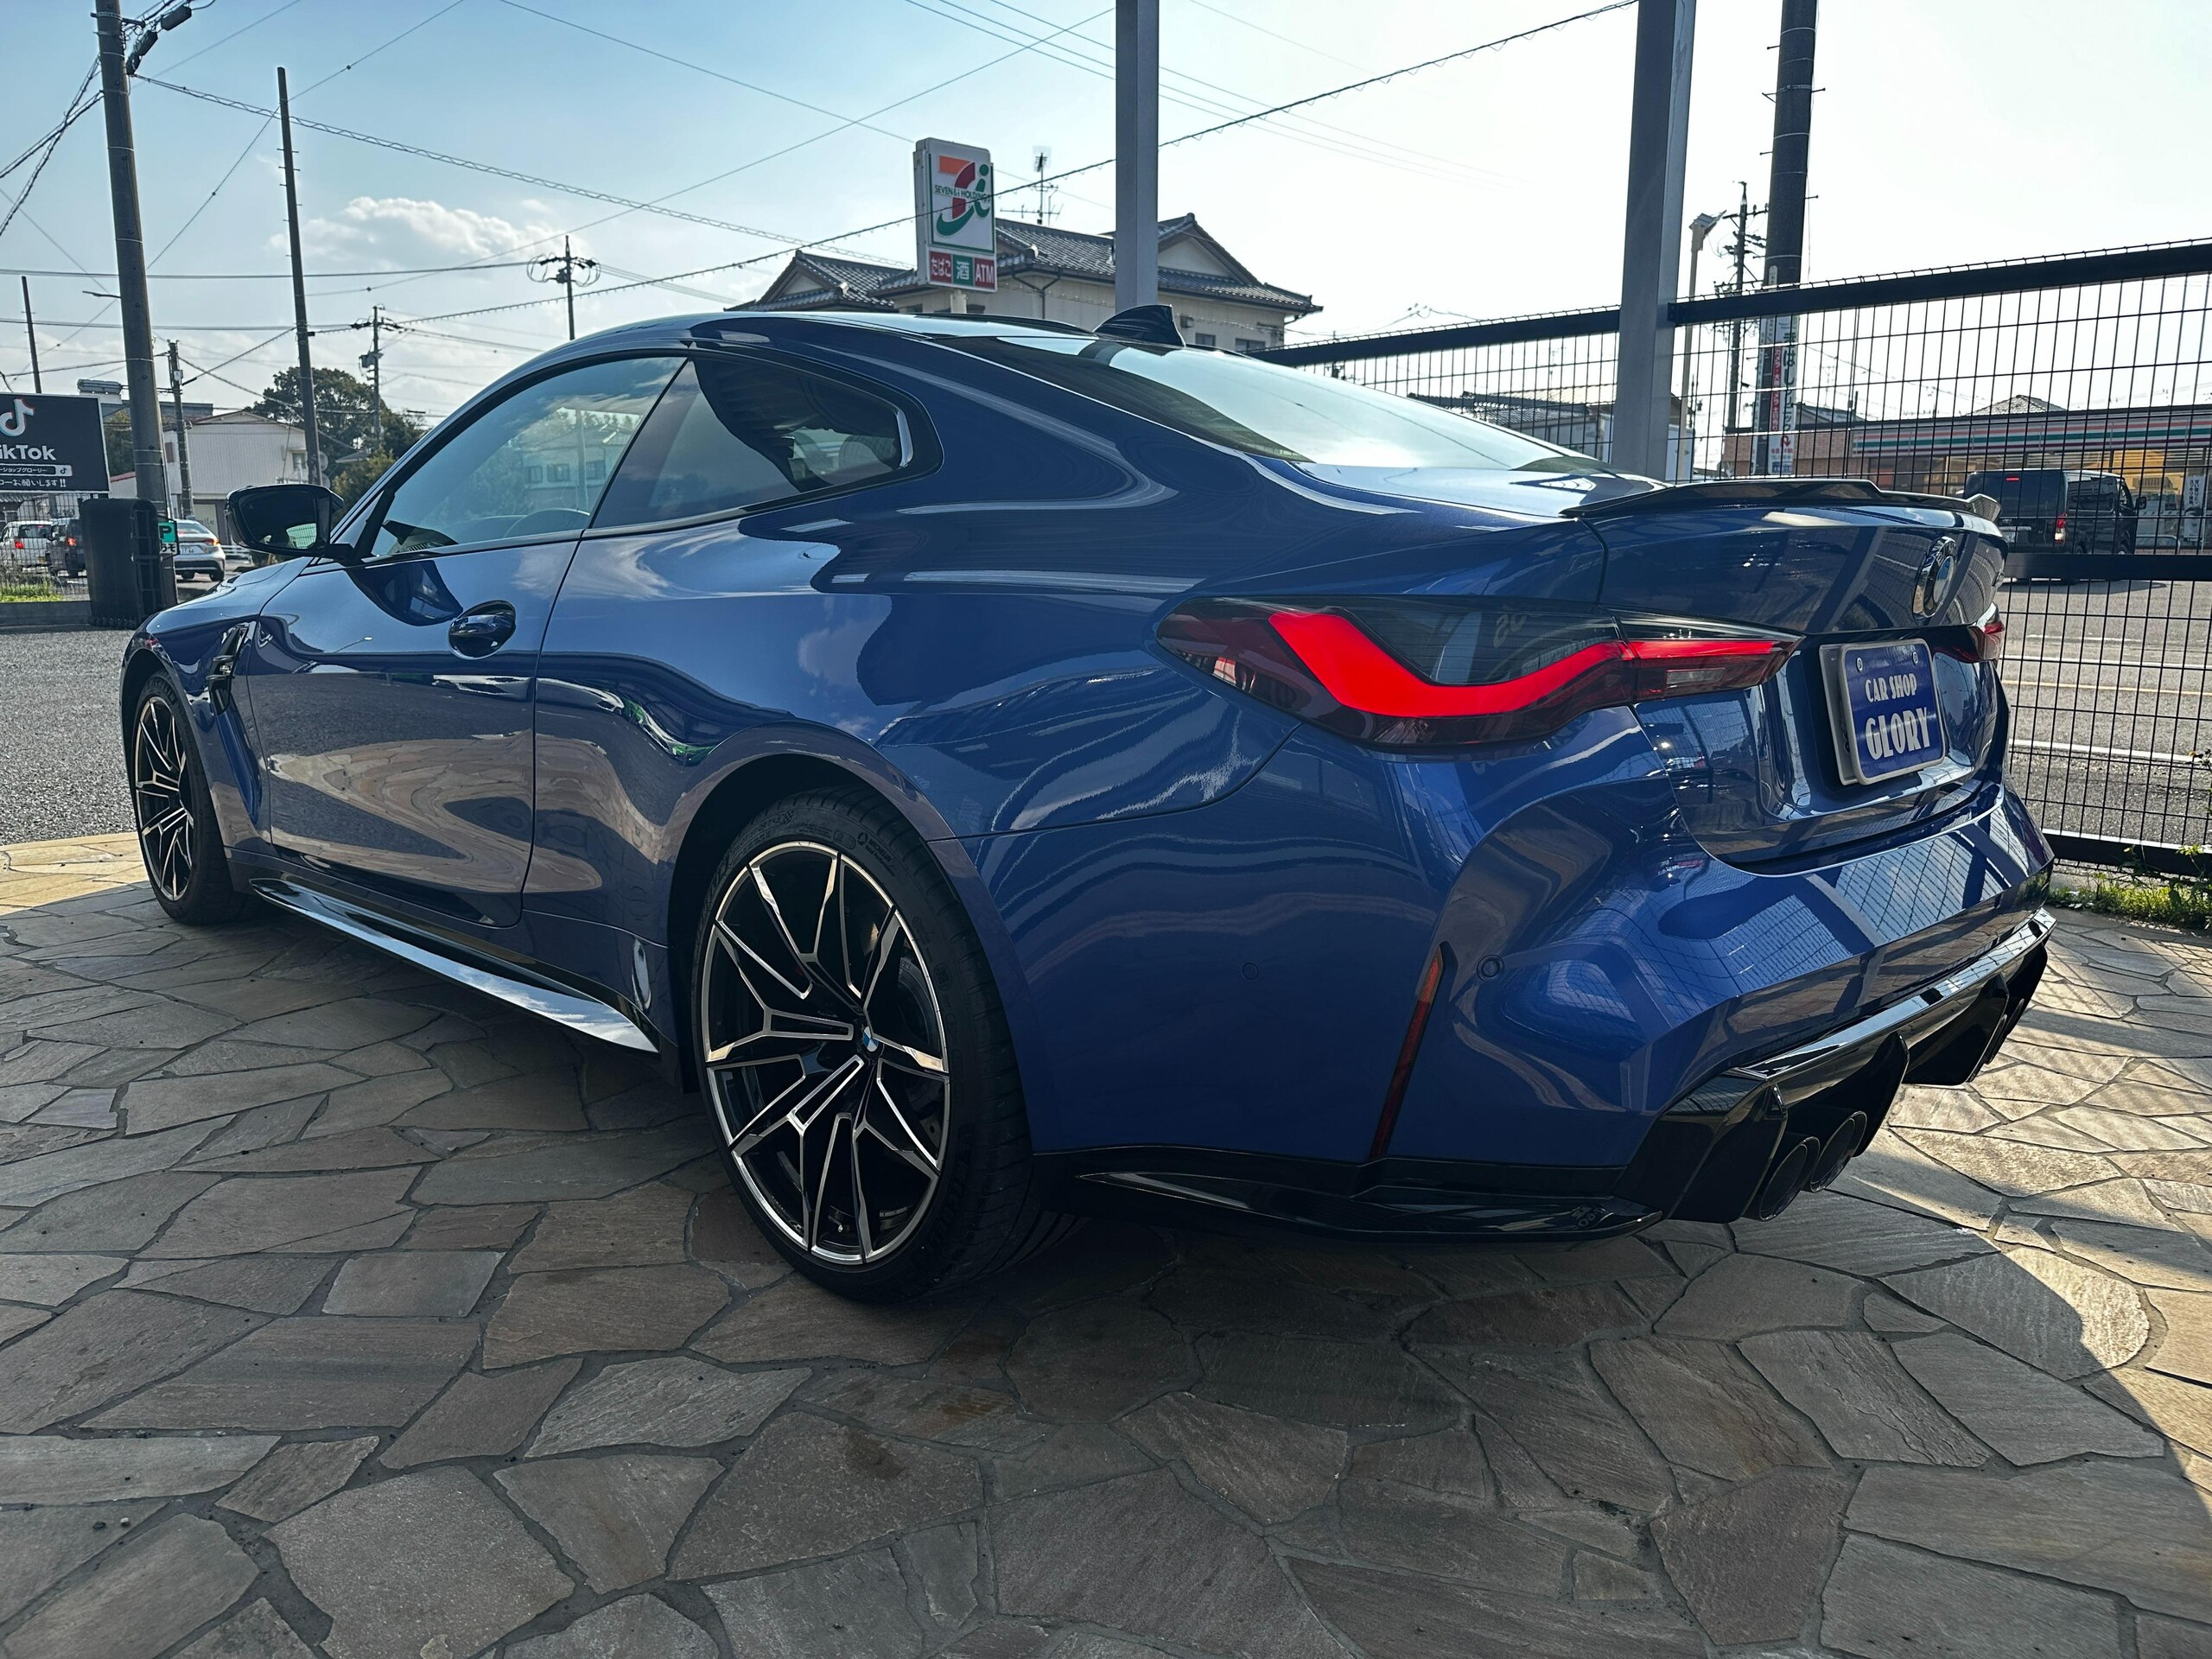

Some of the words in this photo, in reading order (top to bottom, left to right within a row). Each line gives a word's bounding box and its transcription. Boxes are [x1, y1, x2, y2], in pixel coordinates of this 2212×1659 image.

[931, 257, 951, 278] たばこ
[956, 260, 969, 281] 酒
[975, 263, 994, 284] ATM
[159, 525, 173, 539] P
[1865, 677, 1890, 703] CAR
[1889, 672, 1917, 700] SHOP
[1865, 706, 1930, 760] GLORY
